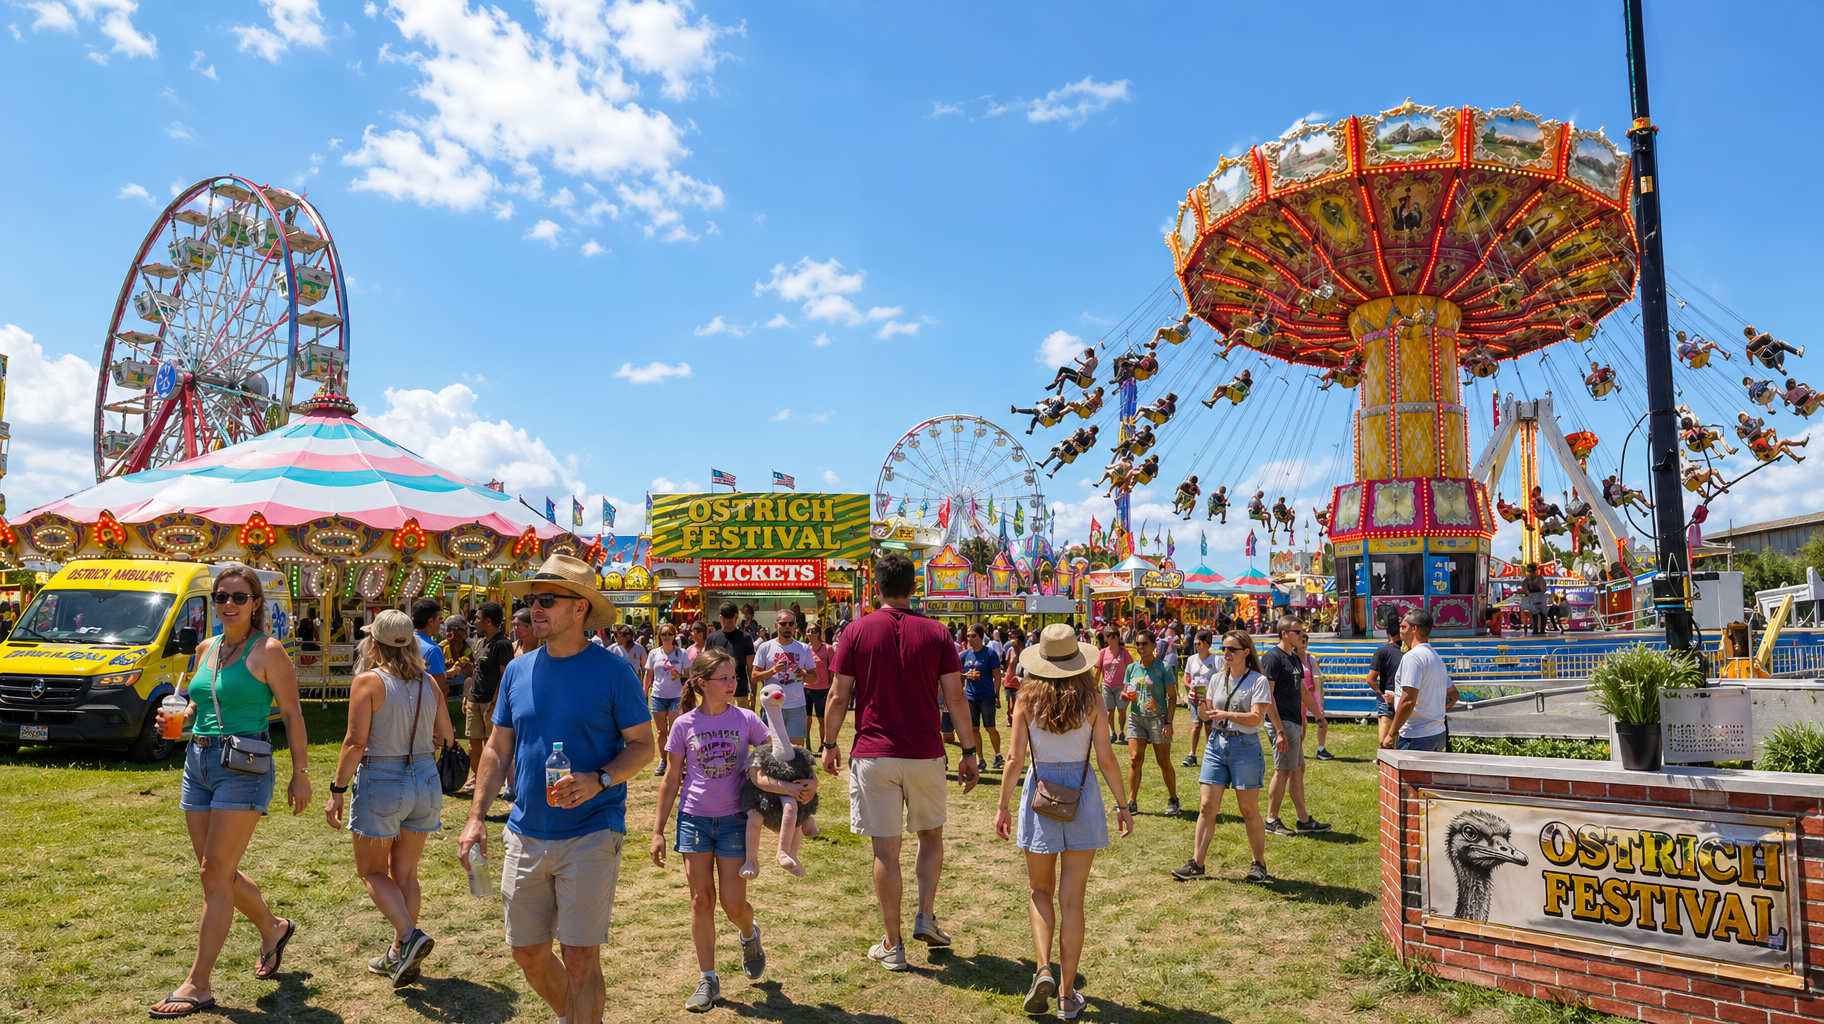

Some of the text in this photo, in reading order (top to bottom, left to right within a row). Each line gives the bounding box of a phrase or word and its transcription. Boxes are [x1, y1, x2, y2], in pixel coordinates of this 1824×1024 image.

[688, 498, 836, 523] OSTRICH
[681, 525, 842, 550] FESTIVAL
[67, 568, 174, 583] OSTRICH AMBULANCE
[709, 564, 815, 581] TICKETS
[1539, 822, 1785, 891] OSTRICH
[1543, 871, 1787, 951] FESTIVAL
